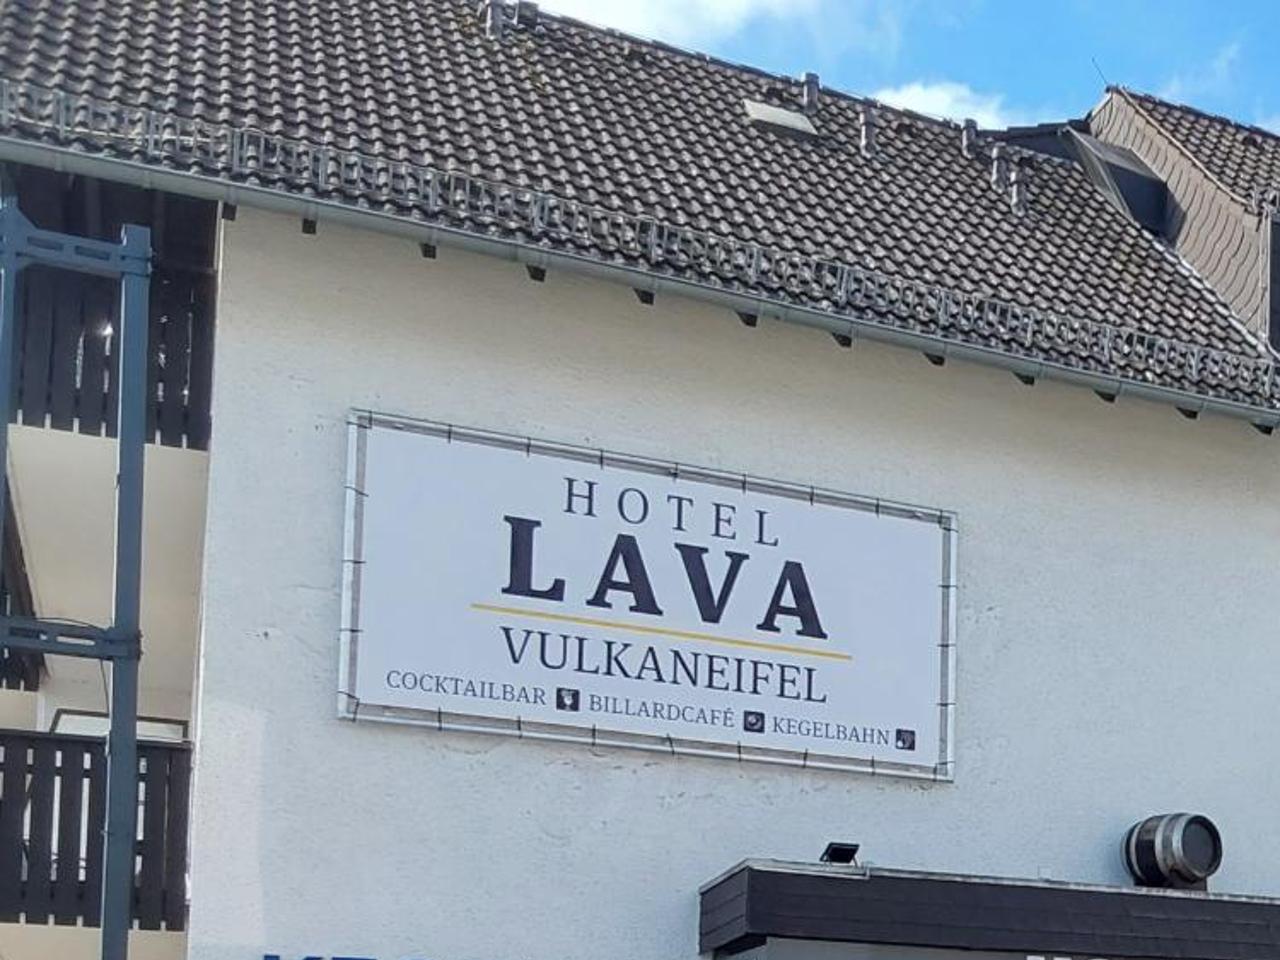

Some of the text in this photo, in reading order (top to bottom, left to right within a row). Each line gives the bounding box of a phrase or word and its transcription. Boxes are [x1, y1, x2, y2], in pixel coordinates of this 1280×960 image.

[563, 477, 779, 547] HOTEL
[501, 515, 828, 639] LAVA
[499, 626, 827, 703] VULKANEIFEL
[386, 670, 890, 745] COCKTAILBAR BILLARDCAFÉ KEGELBAHN
